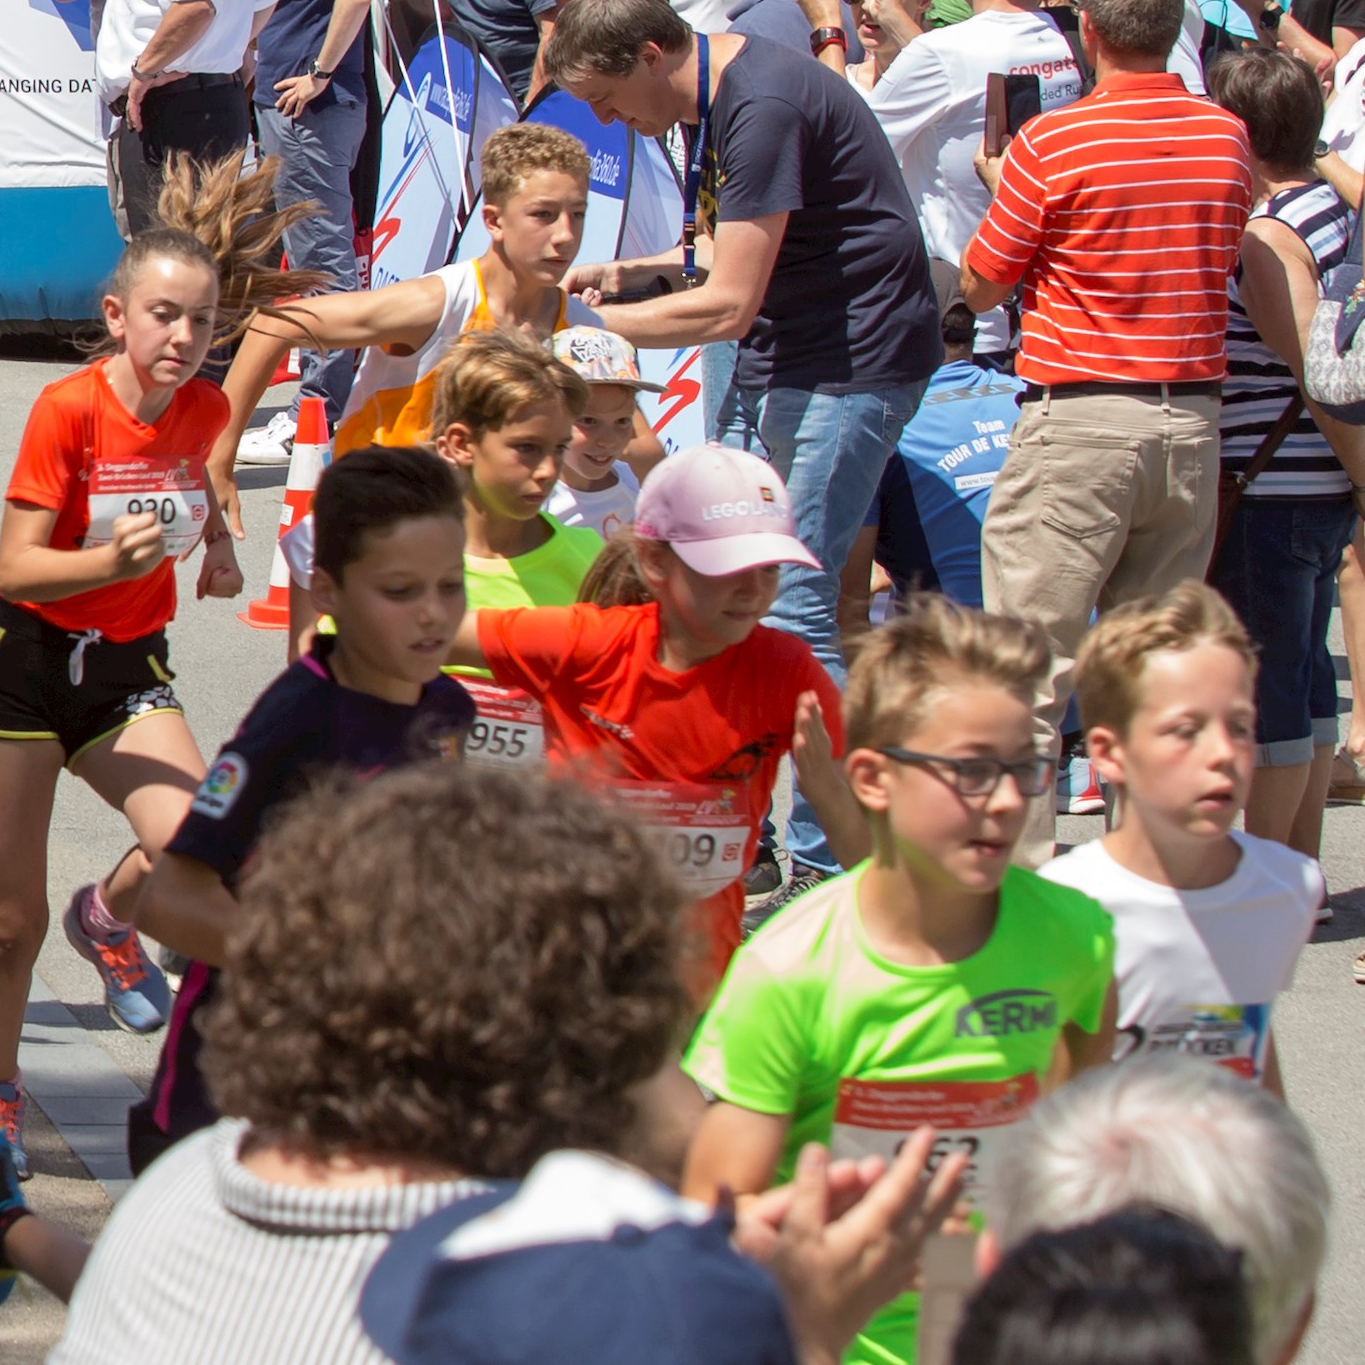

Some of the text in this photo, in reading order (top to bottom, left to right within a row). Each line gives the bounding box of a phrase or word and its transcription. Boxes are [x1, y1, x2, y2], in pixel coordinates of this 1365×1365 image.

[972, 419, 1006, 434] Team
[937, 443, 973, 472] TOUR
[971, 437, 991, 454] DE
[468, 722, 528, 757] 955
